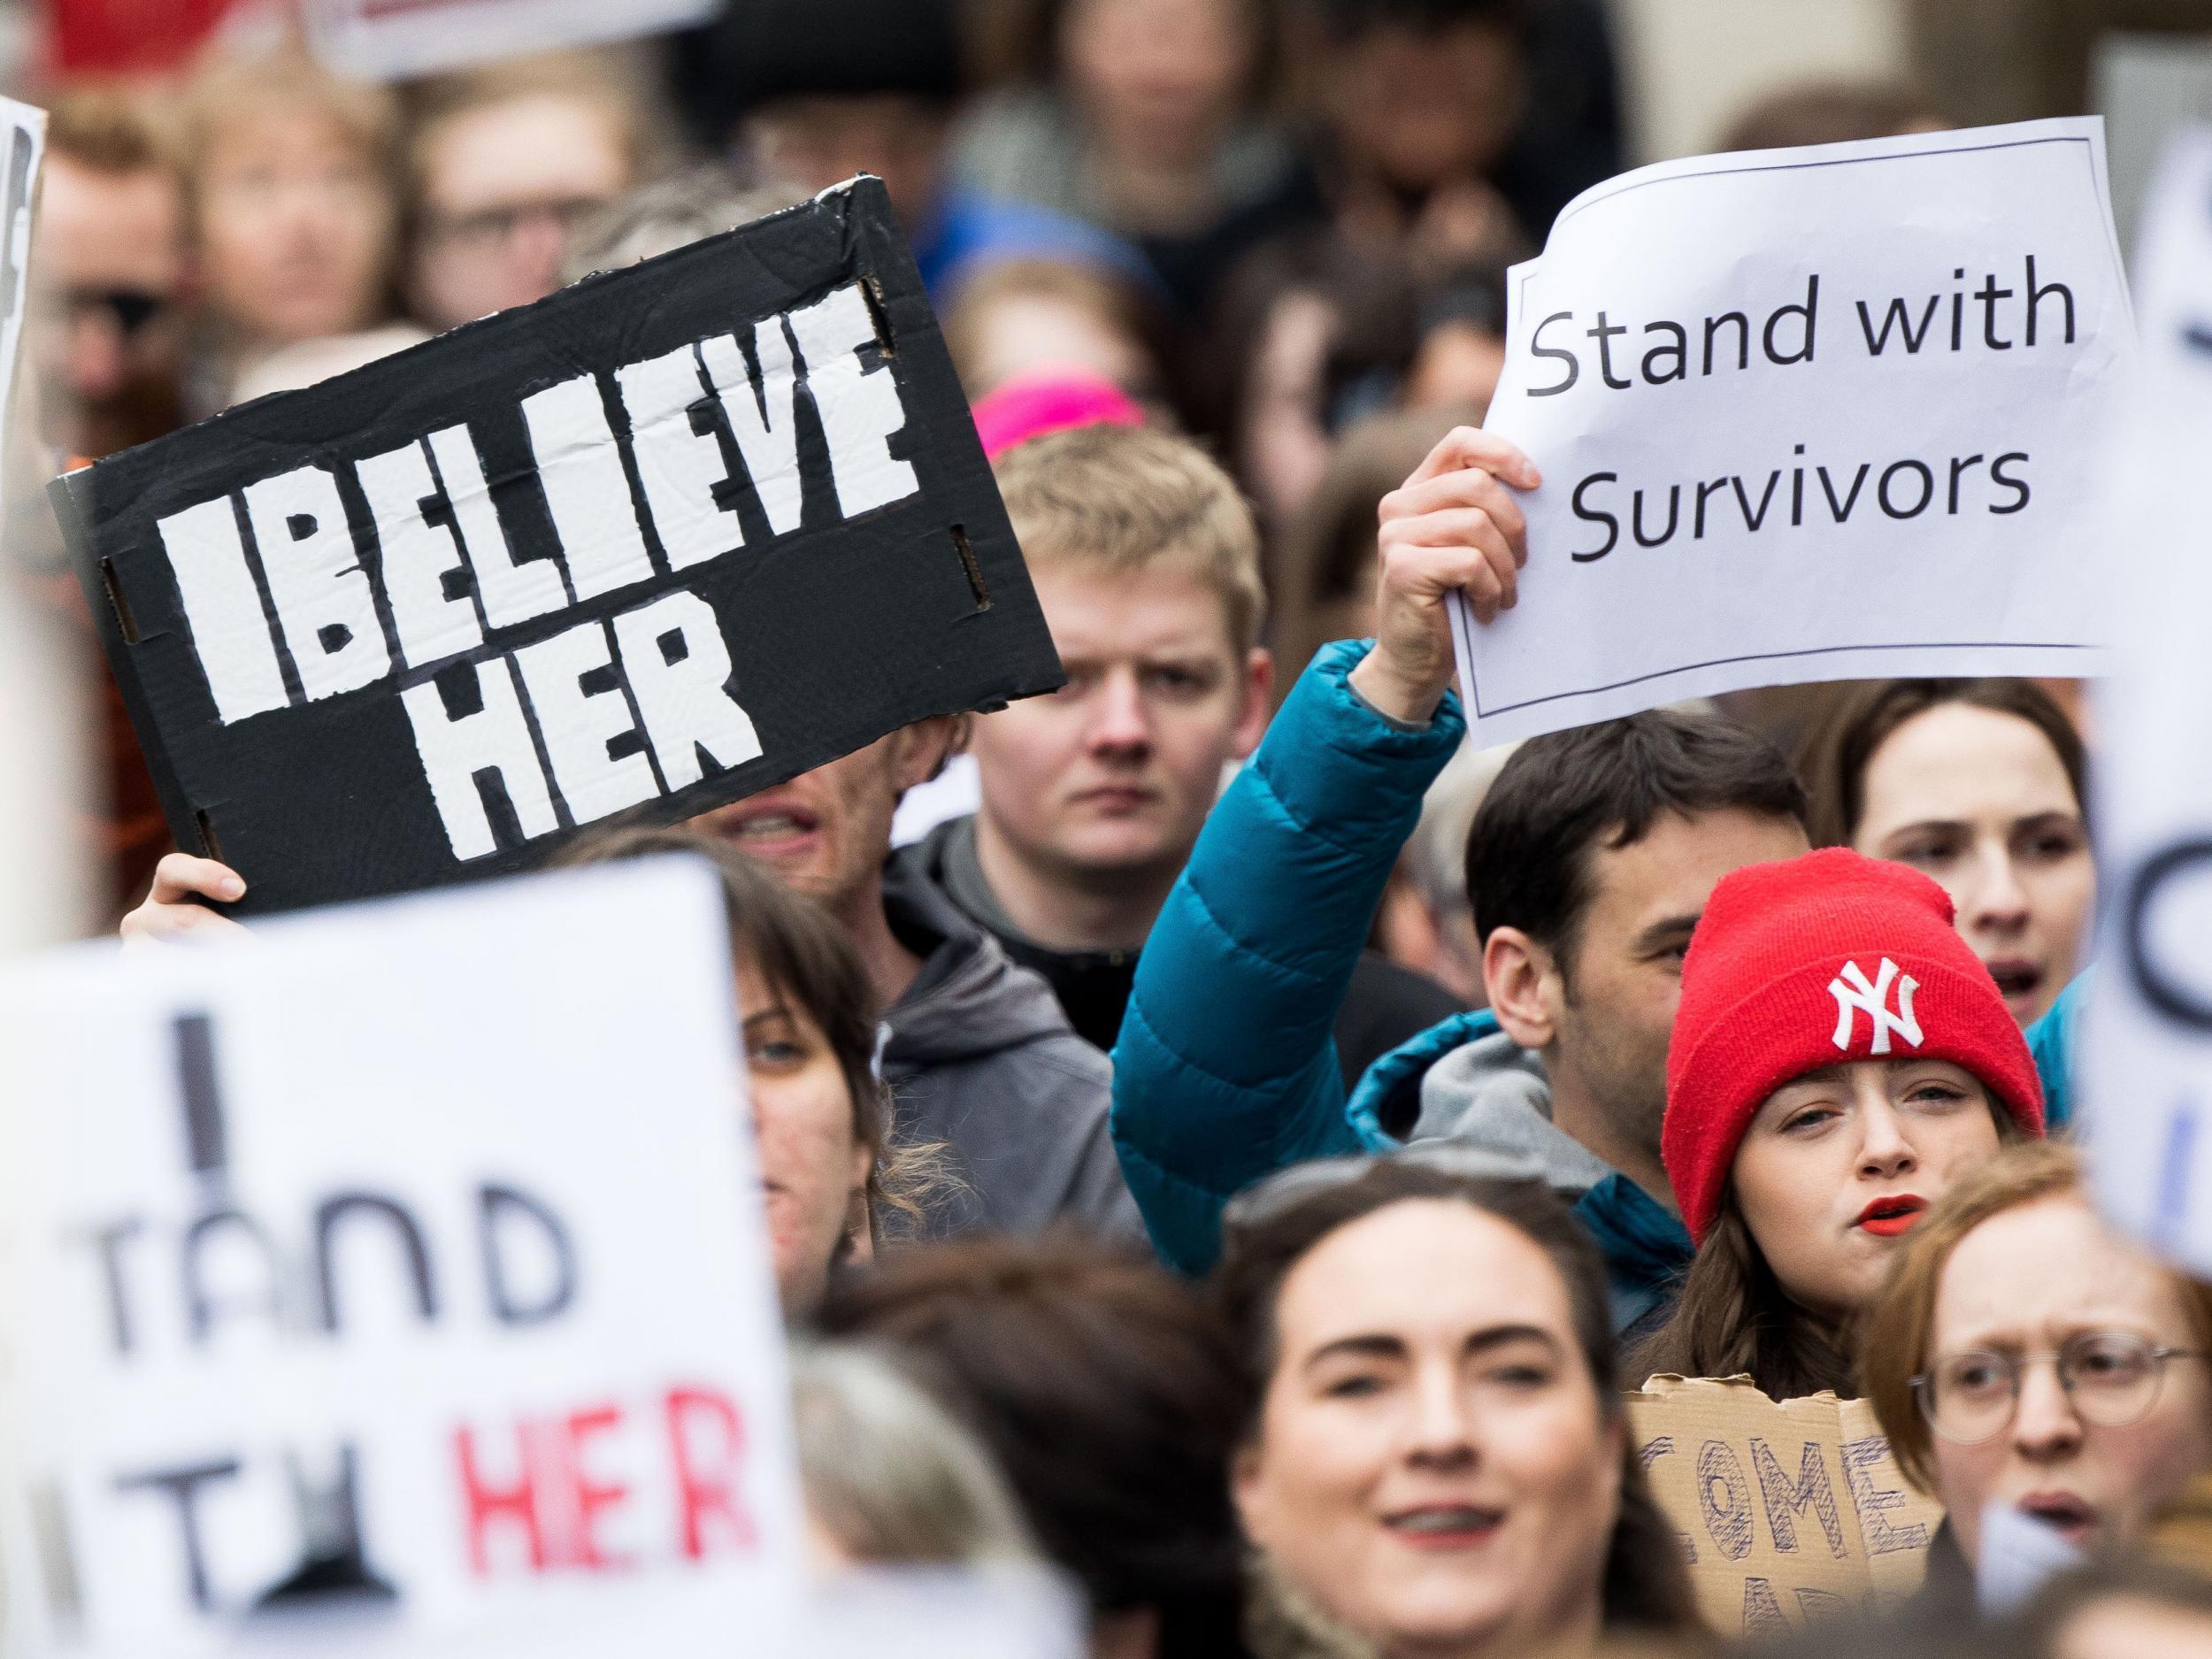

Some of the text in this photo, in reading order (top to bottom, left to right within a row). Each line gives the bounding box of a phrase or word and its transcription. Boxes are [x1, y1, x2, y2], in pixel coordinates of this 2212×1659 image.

[1525, 273, 1820, 398] Stand
[1856, 254, 2076, 357] with
[156, 281, 920, 728] I BELIEVE
[1570, 443, 2032, 564] Survivors
[399, 588, 764, 863] HER
[1826, 956, 1925, 1056] NY
[452, 1385, 763, 1578] HER
